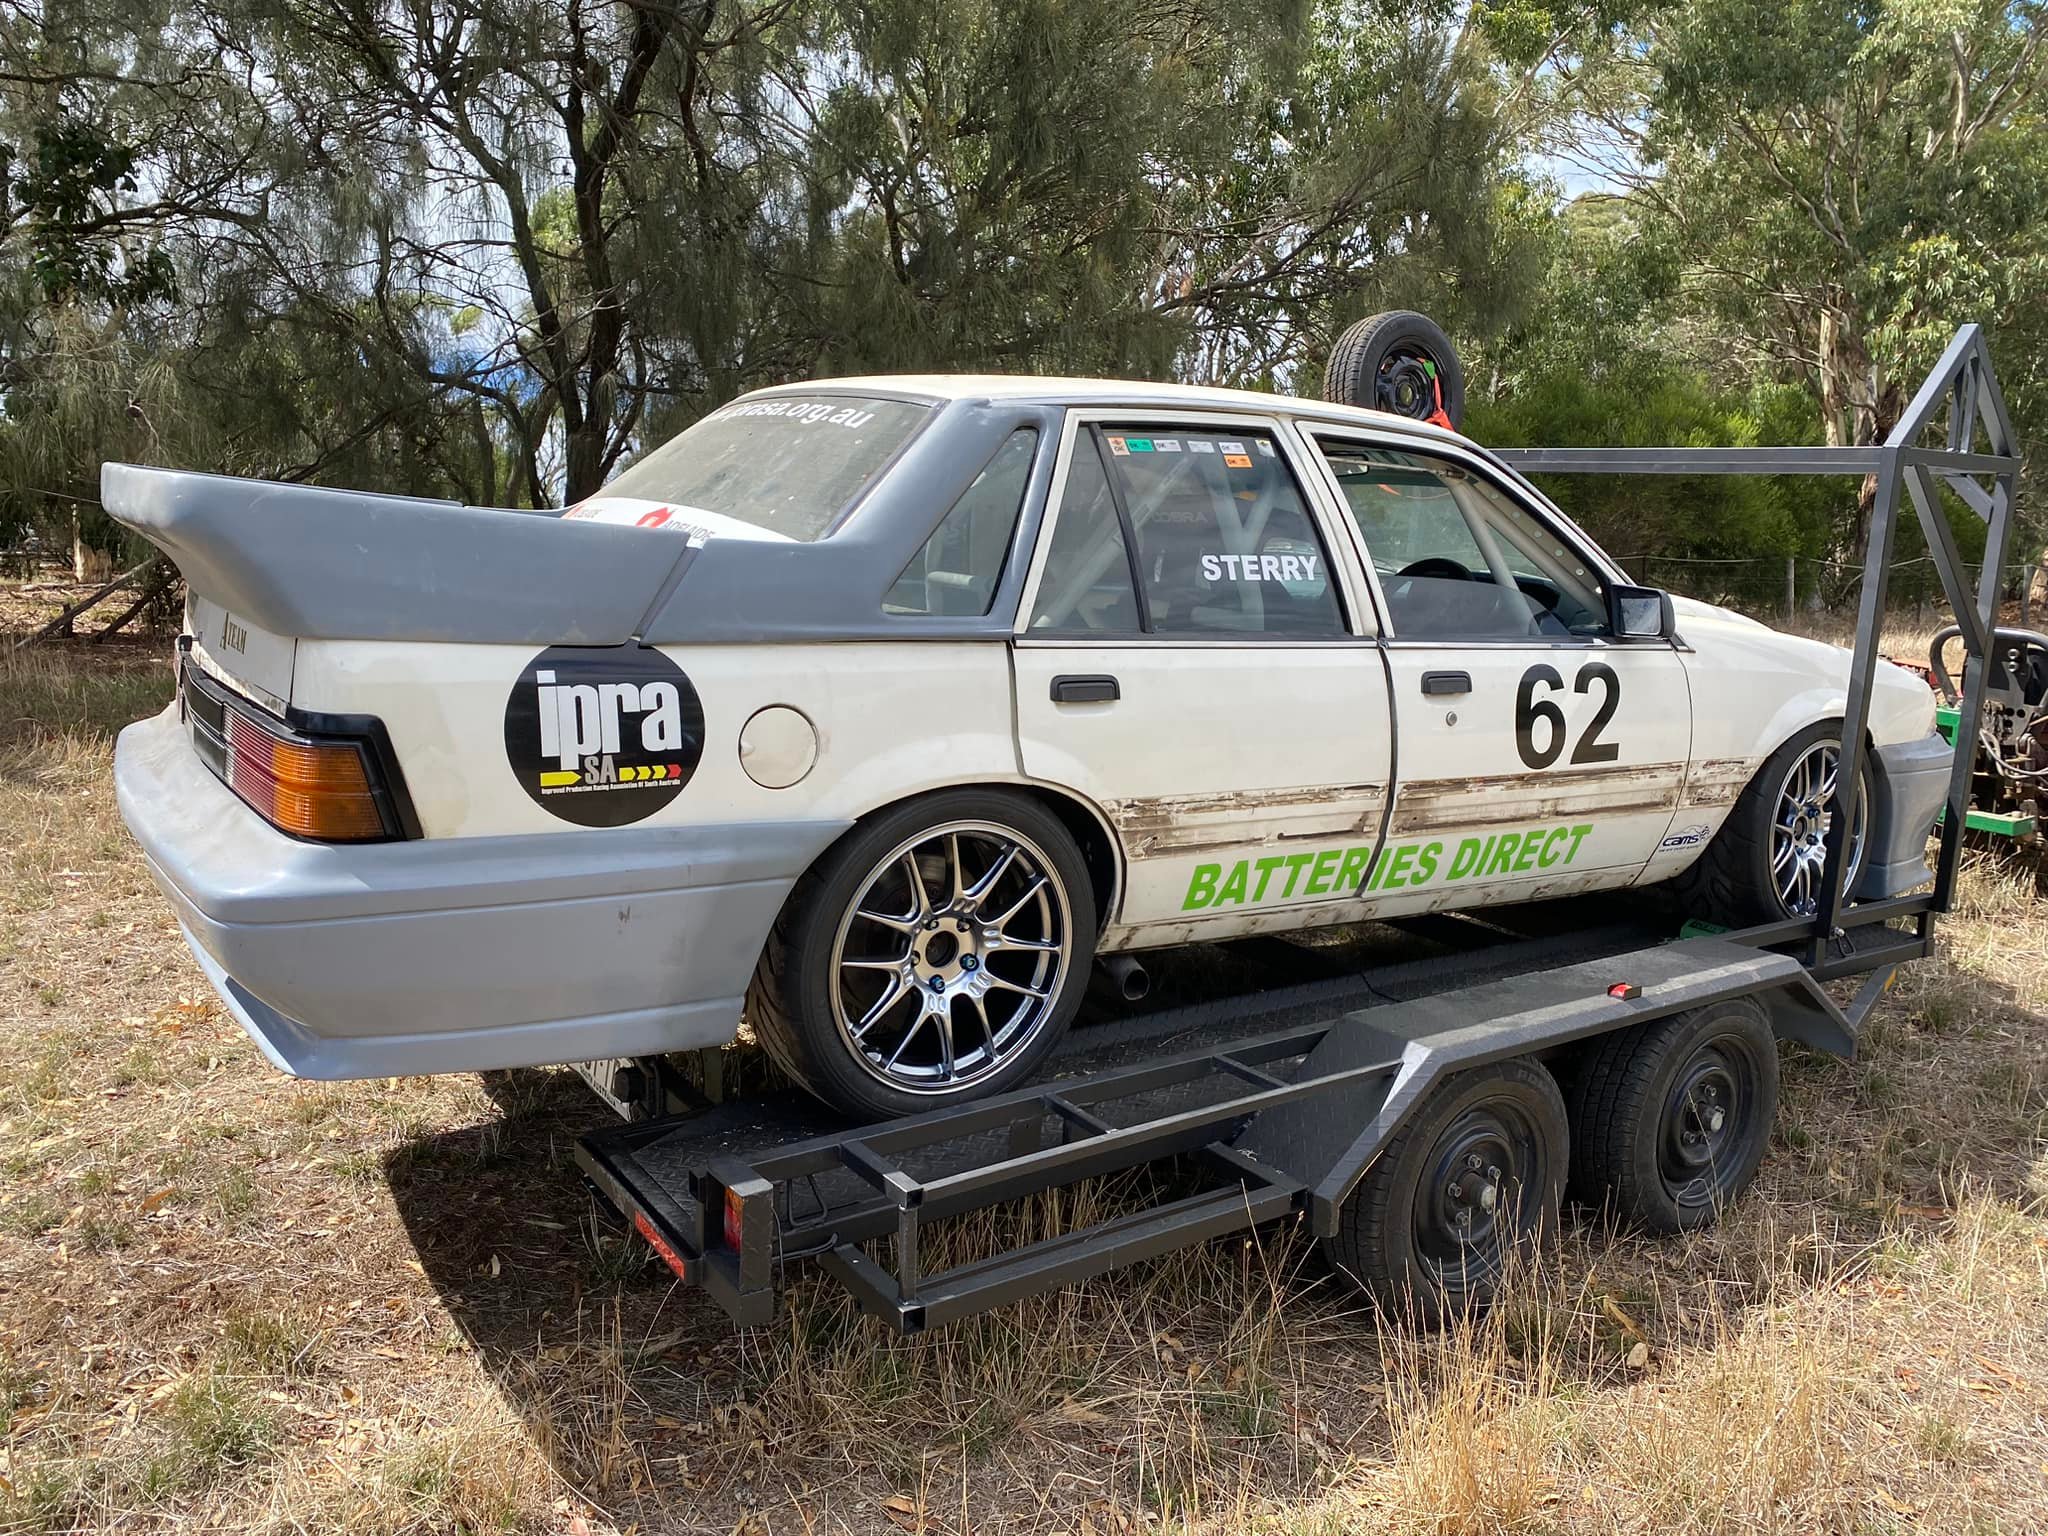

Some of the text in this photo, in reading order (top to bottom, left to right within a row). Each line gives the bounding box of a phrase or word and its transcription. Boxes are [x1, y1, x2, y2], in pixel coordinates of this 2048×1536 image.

[1202, 555, 1317, 581] STERRY
[536, 669, 683, 771] ipra
[1515, 662, 1621, 770] 62
[584, 755, 617, 785] SA
[1181, 824, 1594, 911] BATTERIES DIRECT
[1663, 836, 1699, 846] cams
